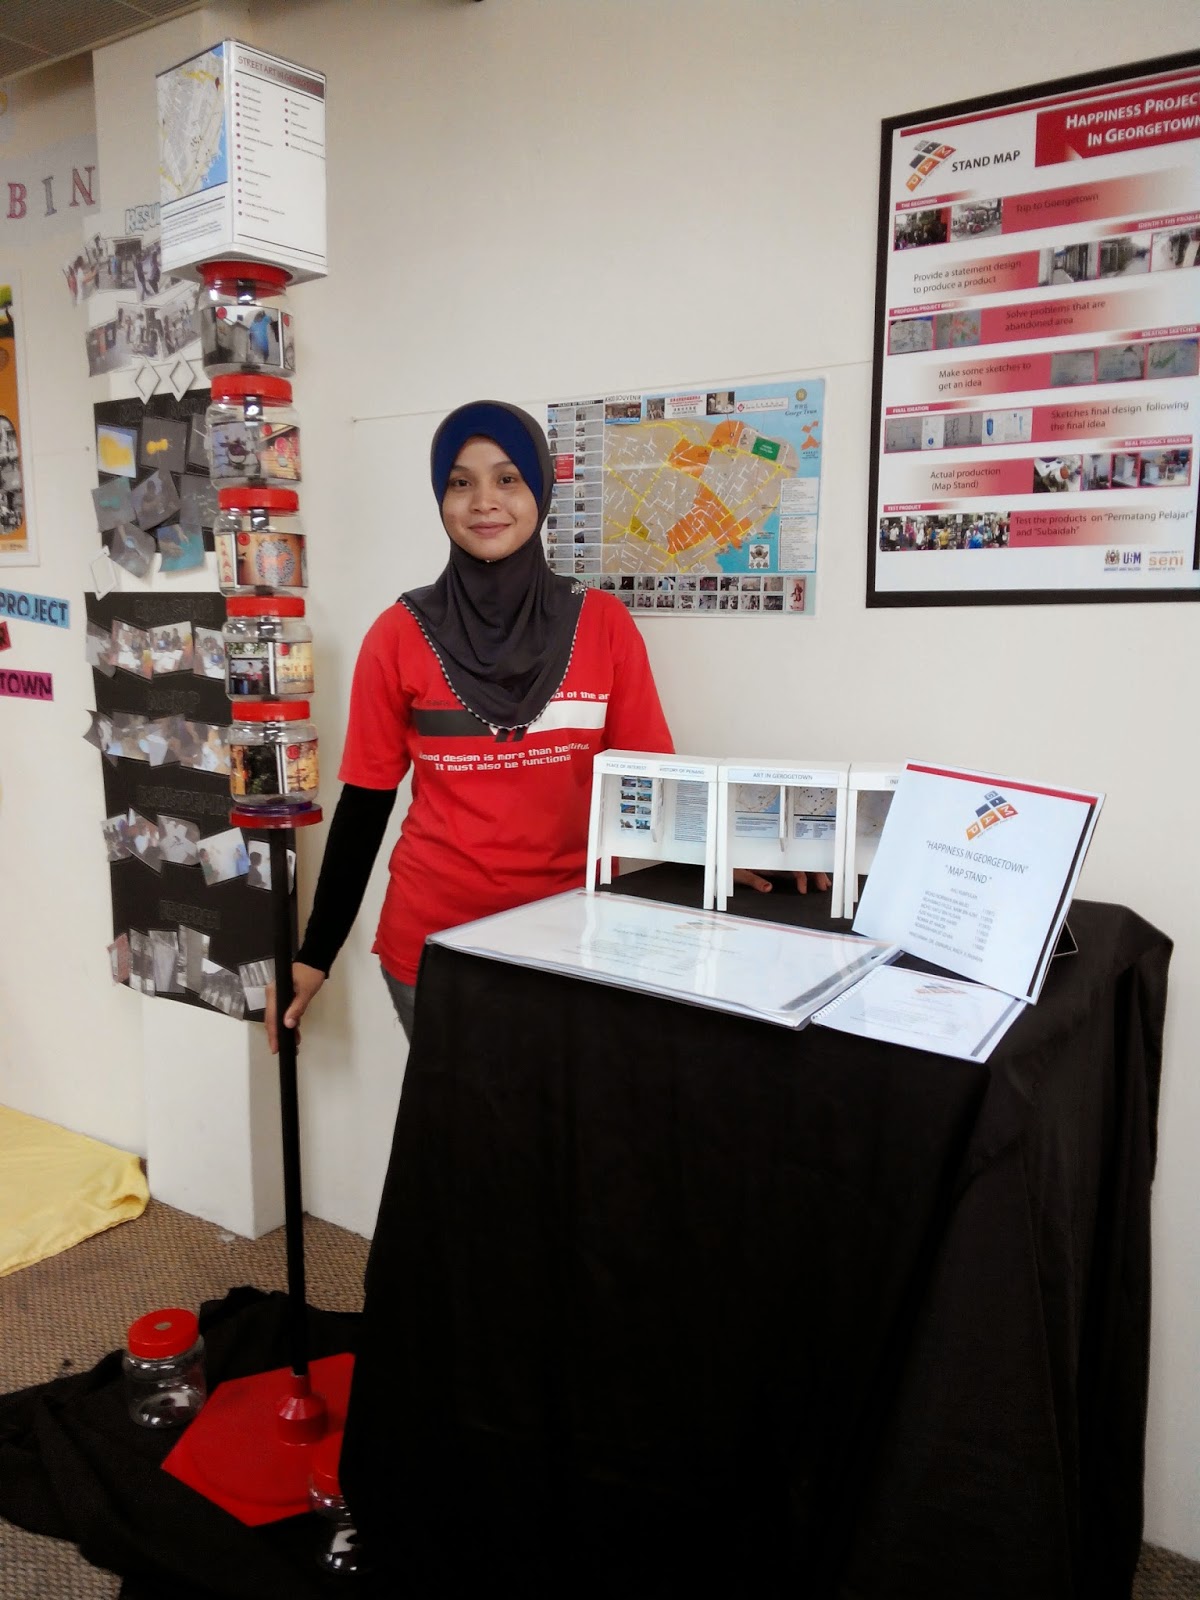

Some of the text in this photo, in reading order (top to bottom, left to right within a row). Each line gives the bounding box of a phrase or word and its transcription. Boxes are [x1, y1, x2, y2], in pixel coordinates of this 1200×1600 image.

[238, 56, 262, 72] STREET
[264, 66, 276, 77] ART
[1066, 92, 1200, 129] HAPPINESS PROJEC
[1088, 132, 1102, 147] IN
[952, 150, 1020, 172] STAND MAP
[914, 272, 942, 282] Provide
[952, 264, 992, 277] statement
[994, 260, 1021, 271] design
[923, 282, 956, 294] produce
[964, 276, 996, 289] product
[1006, 300, 1106, 320] Solve problems that are
[1005, 317, 1074, 332] abandoned area
[939, 370, 960, 378] Make
[986, 362, 1020, 374] sketches
[938, 382, 952, 392] get
[965, 379, 982, 388] idea
[1051, 401, 1189, 419] Sketches final design following
[1051, 420, 1106, 432] the final idea
[930, 468, 1000, 480] Actual production
[932, 480, 978, 491] (Map Stand)
[1015, 516, 1031, 525] Test
[1034, 516, 1046, 524] the
[1050, 514, 1087, 526] products
[1016, 528, 1032, 536] and
[1148, 555, 1184, 566] seni
[0, 592, 68, 625] PROJECT
[566, 691, 577, 699] of
[580, 691, 596, 700] the
[442, 754, 480, 762] design
[498, 752, 525, 760] more
[528, 748, 552, 756] than
[447, 764, 474, 772] must
[477, 762, 501, 770] also
[522, 754, 571, 766] functiona
[966, 850, 972, 860] IN
[964, 870, 988, 884] STAND
